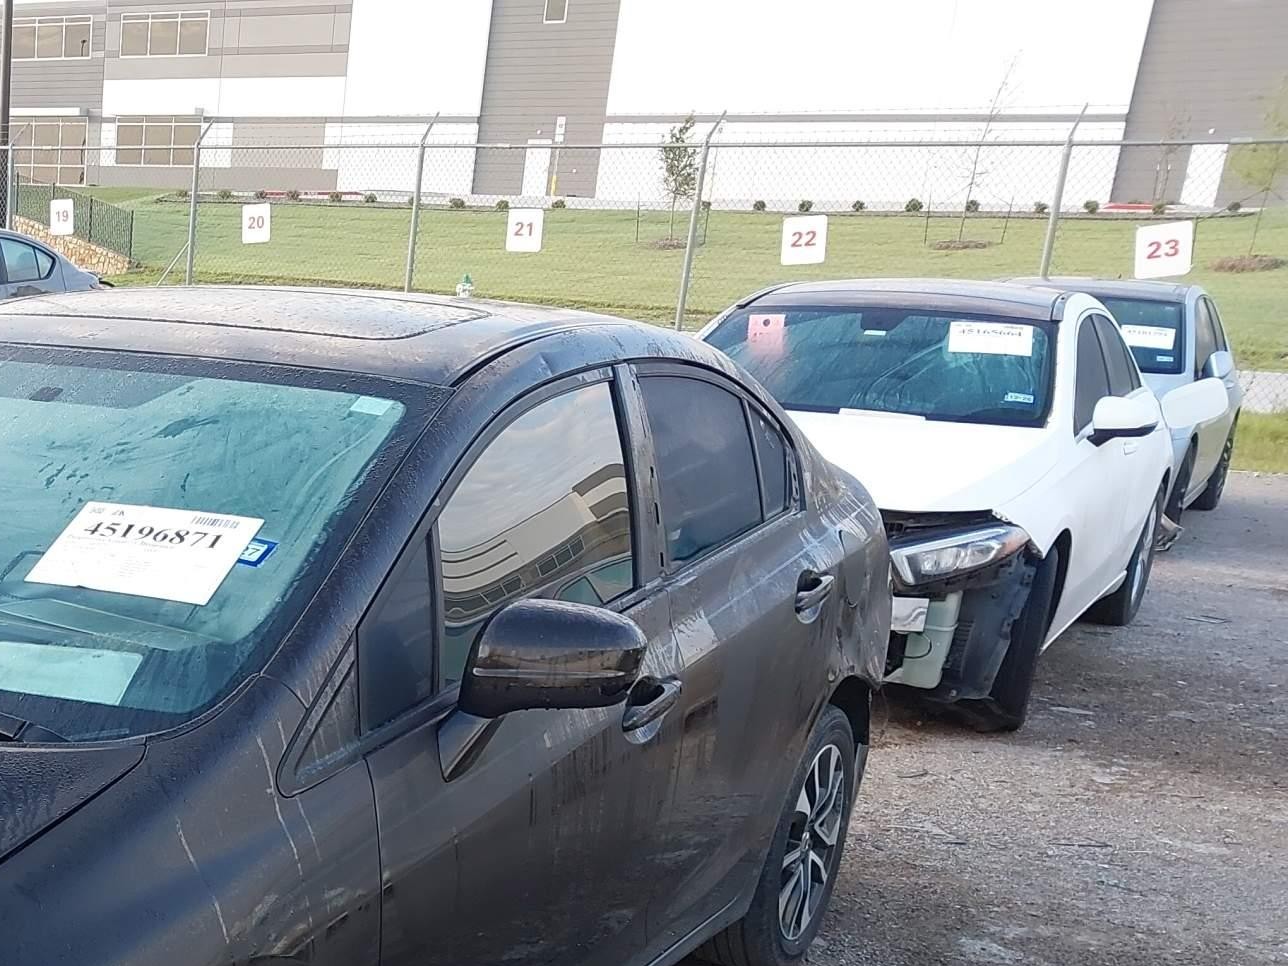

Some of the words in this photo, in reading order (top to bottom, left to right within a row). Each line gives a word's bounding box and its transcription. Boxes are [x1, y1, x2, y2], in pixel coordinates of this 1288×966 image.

[55, 210, 69, 222] 19
[247, 215, 265, 229] 20
[514, 221, 533, 236] 21
[790, 230, 817, 247] 22
[1146, 239, 1180, 259] 23
[83, 521, 224, 550] 45196871
